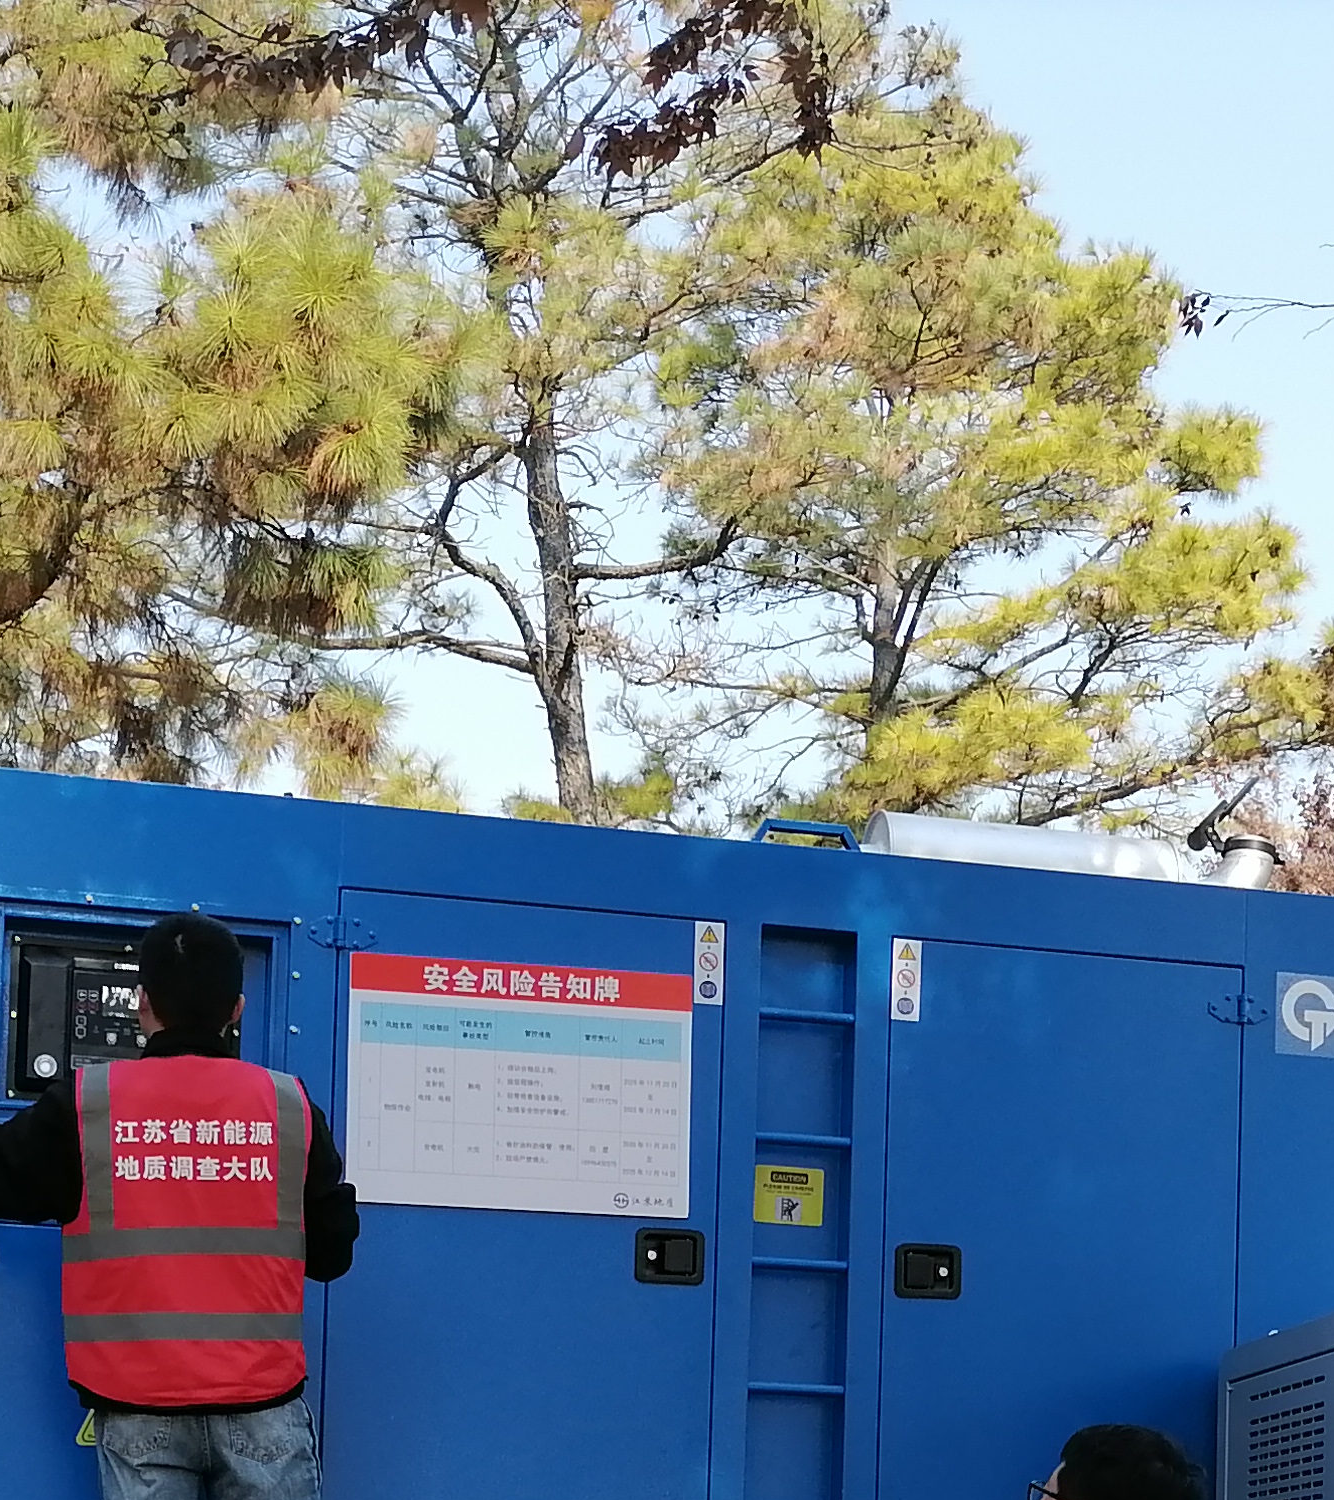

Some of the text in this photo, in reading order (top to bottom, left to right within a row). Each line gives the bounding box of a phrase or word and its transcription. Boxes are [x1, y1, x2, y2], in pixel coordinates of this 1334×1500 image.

[423, 964, 621, 1002] 安全风险告知牌
[114, 1119, 274, 1146] 江苏省新能源
[114, 1156, 274, 1182] 地质调查大队
[772, 1173, 807, 1183] CAUTION
